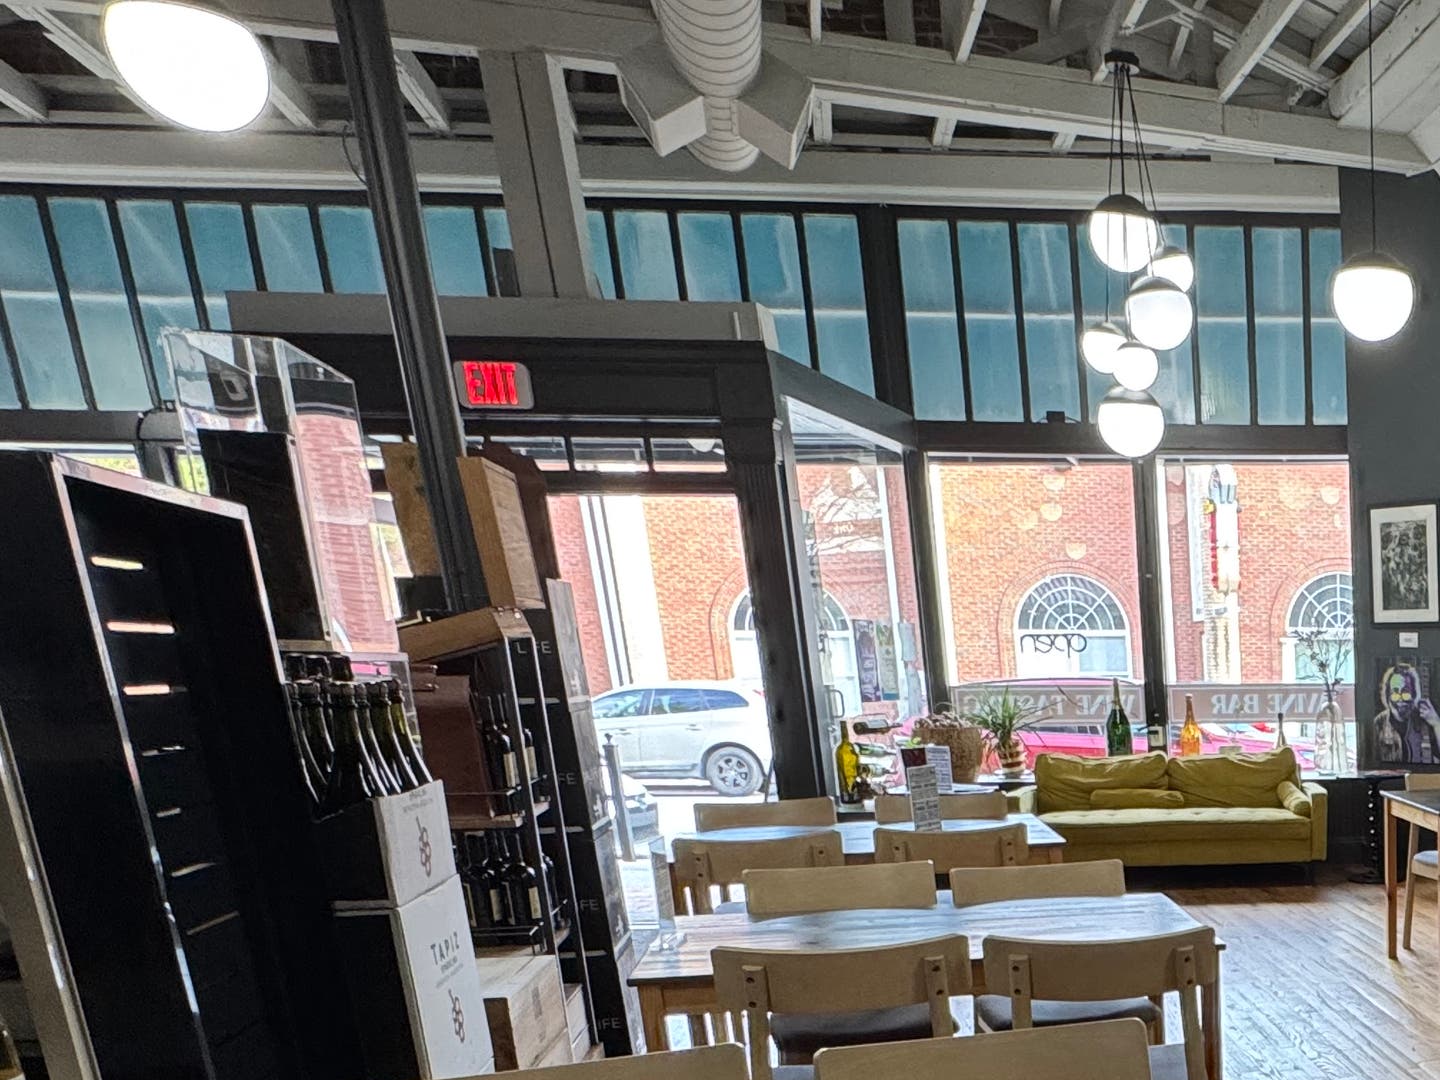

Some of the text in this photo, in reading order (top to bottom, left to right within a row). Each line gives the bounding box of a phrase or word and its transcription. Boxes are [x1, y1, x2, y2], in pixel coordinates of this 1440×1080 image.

[463, 361, 519, 405] EXIT
[514, 640, 552, 654] LFE
[430, 931, 460, 966] TAPIZ
